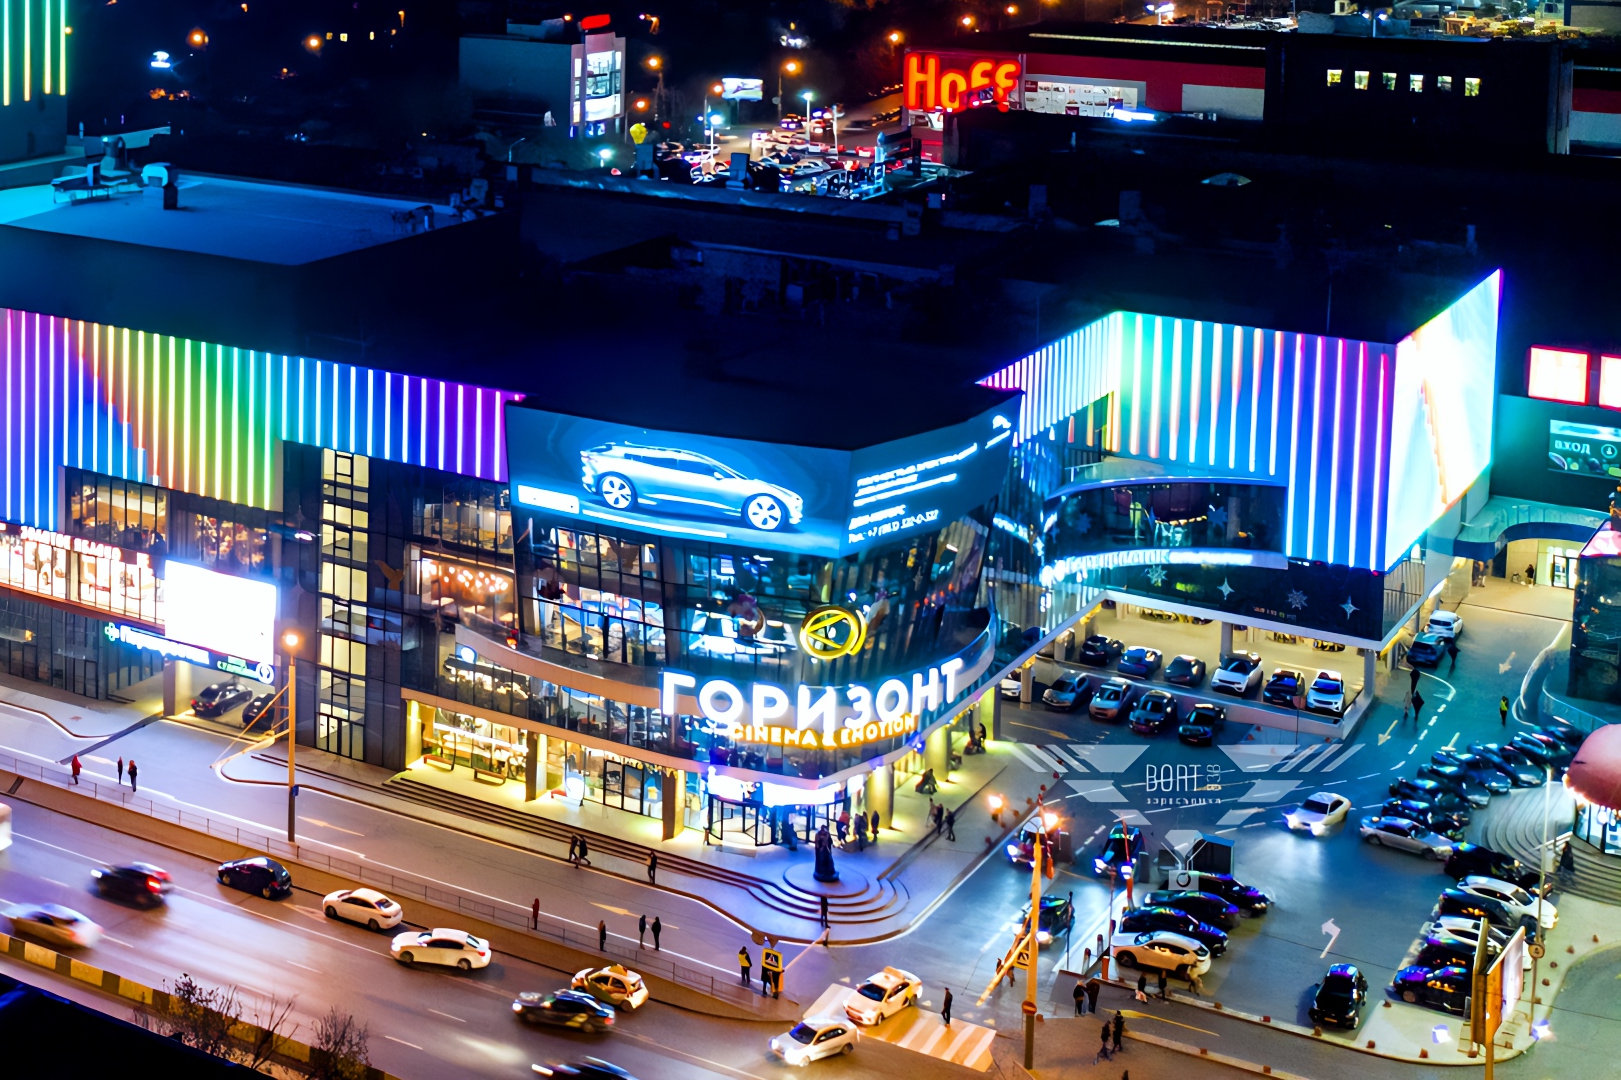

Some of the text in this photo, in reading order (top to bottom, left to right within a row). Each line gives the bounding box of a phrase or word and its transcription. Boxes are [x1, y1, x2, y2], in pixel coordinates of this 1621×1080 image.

[905, 53, 1021, 112] Hoff
[661, 657, 964, 732] ГОРИЗОНТ
[732, 724, 817, 747] CINEMA
[840, 713, 917, 745] EMOTION
